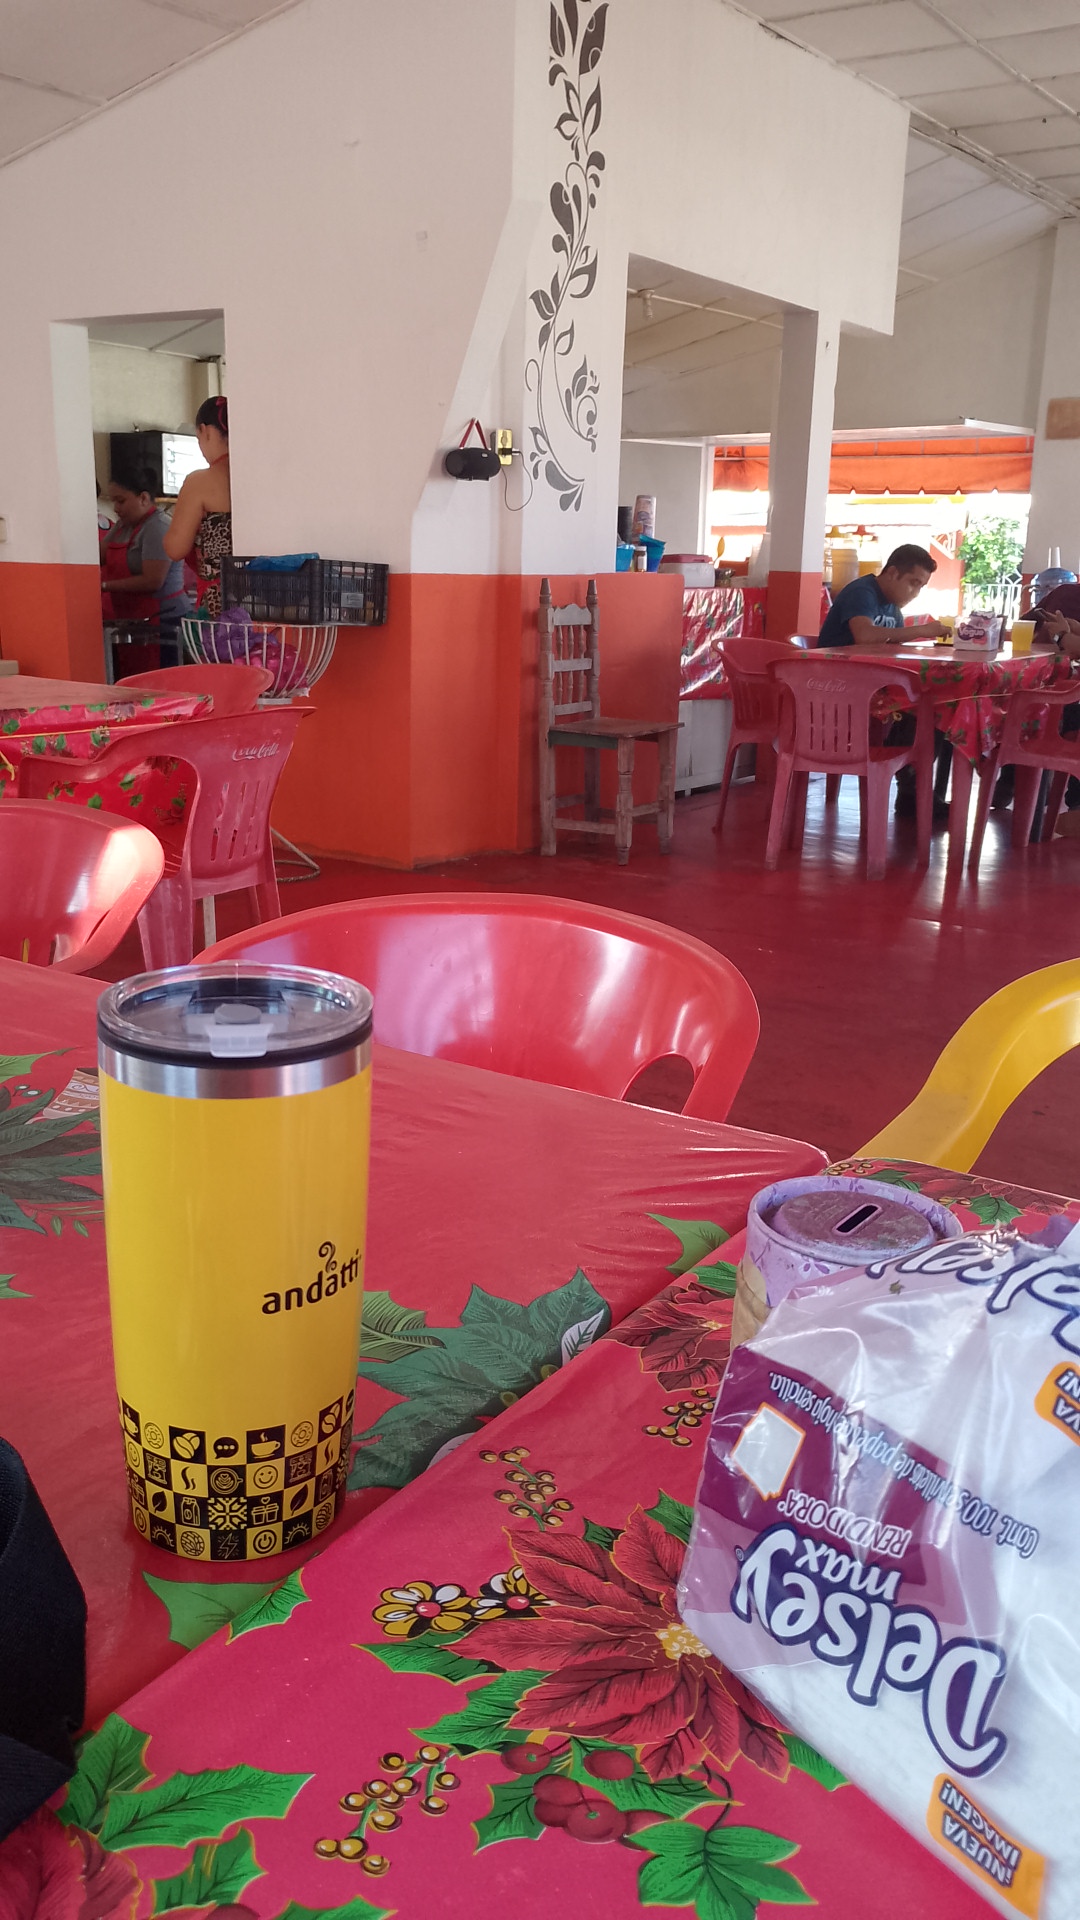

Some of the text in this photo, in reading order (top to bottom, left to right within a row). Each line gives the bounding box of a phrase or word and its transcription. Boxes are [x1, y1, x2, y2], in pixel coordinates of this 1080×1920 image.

[261, 1248, 361, 1315] andatti
[892, 1453, 915, 1480] de
[961, 1497, 999, 1536] 100
[997, 1515, 1040, 1559] Cont.
[795, 1537, 902, 1602] max
[730, 1524, 1008, 1778] Delsey
[938, 1778, 1022, 1873] IMAGEN!
